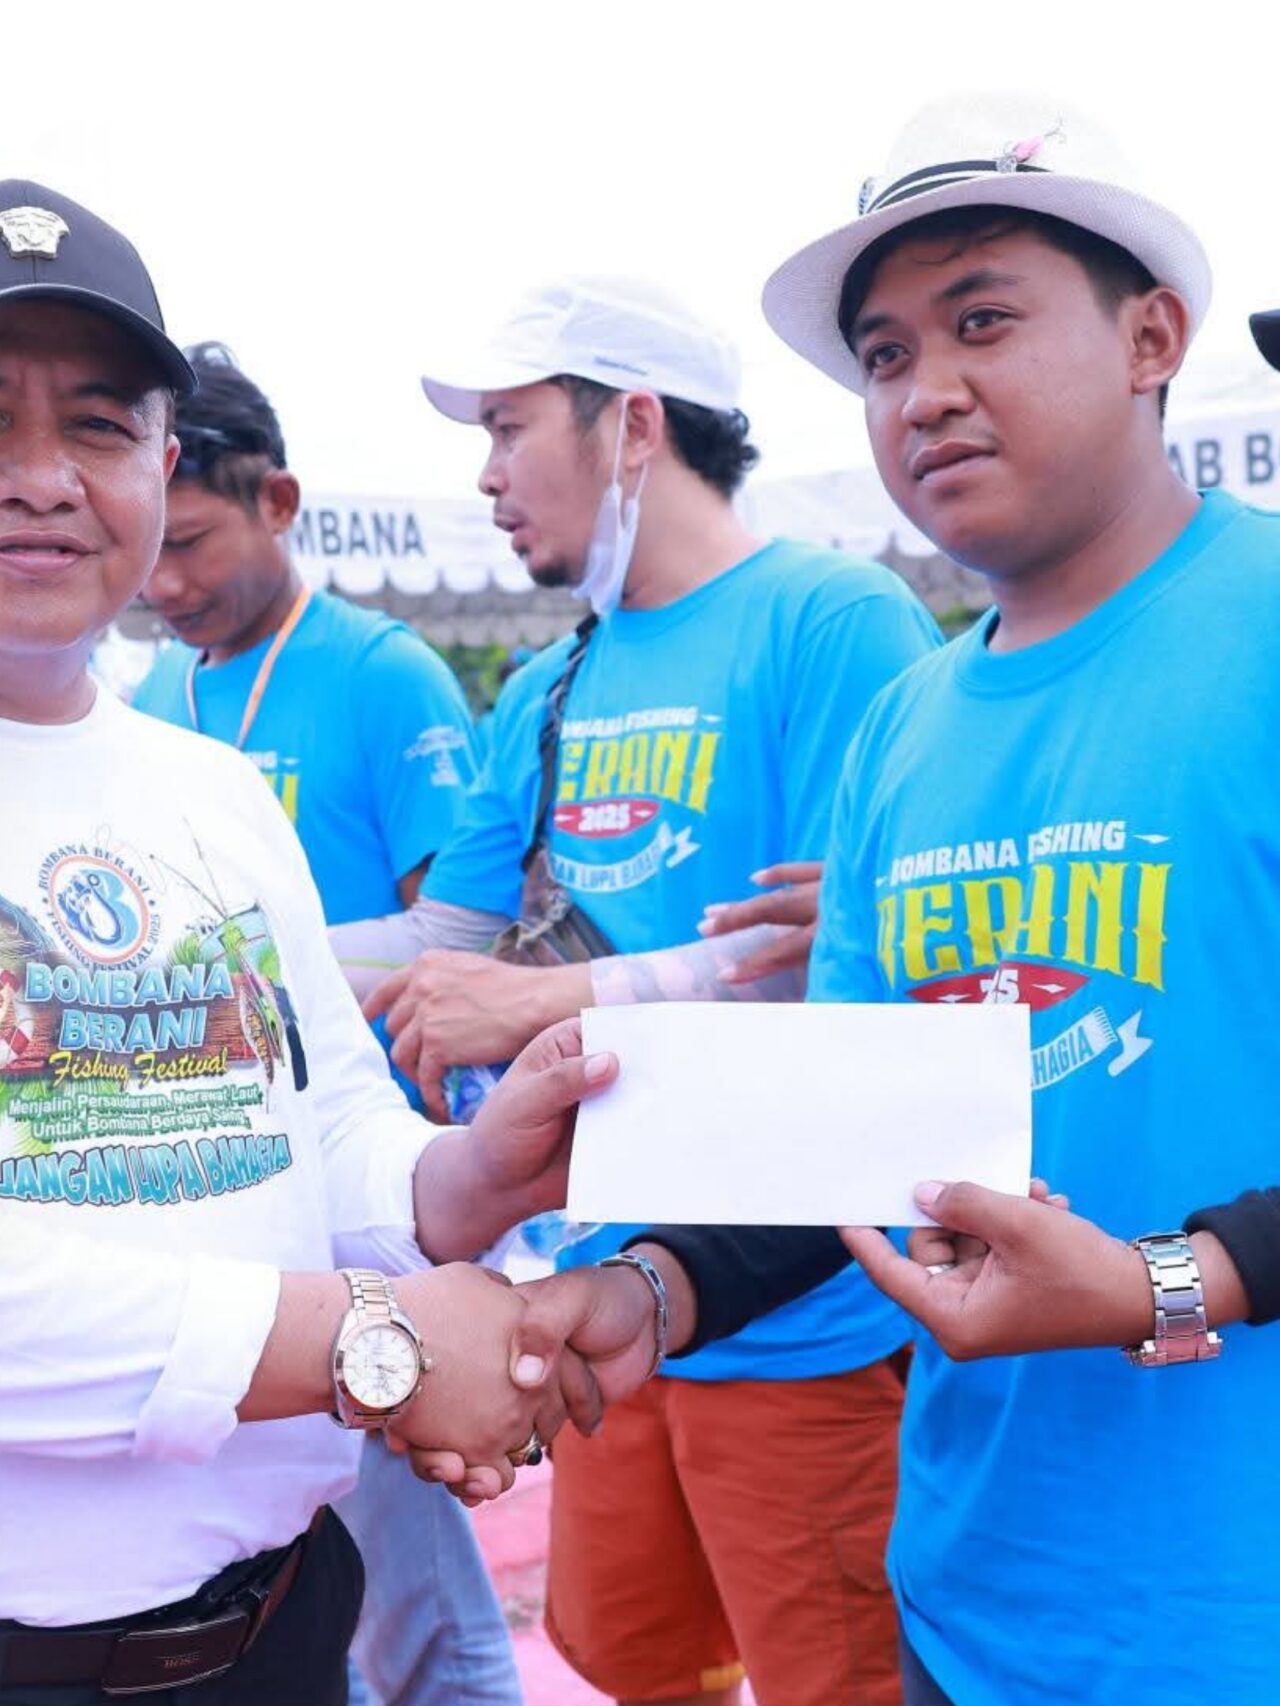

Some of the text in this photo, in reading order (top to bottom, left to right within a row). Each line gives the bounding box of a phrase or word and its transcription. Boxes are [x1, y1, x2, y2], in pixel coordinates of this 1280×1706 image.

[291, 508, 427, 556] MBANA
[557, 731, 721, 816] ERANI
[25, 962, 235, 1008] BOMBANA
[58, 1006, 207, 1054] BERANI
[48, 1047, 229, 1088] Fishing Festival
[1031, 1025, 1094, 1087] HAGIA
[9, 1096, 73, 1118] Menjalin
[33, 1118, 83, 1141] Untuk
[128, 1139, 210, 1206] LUPA
[195, 1133, 293, 1197] BAHAGIA
